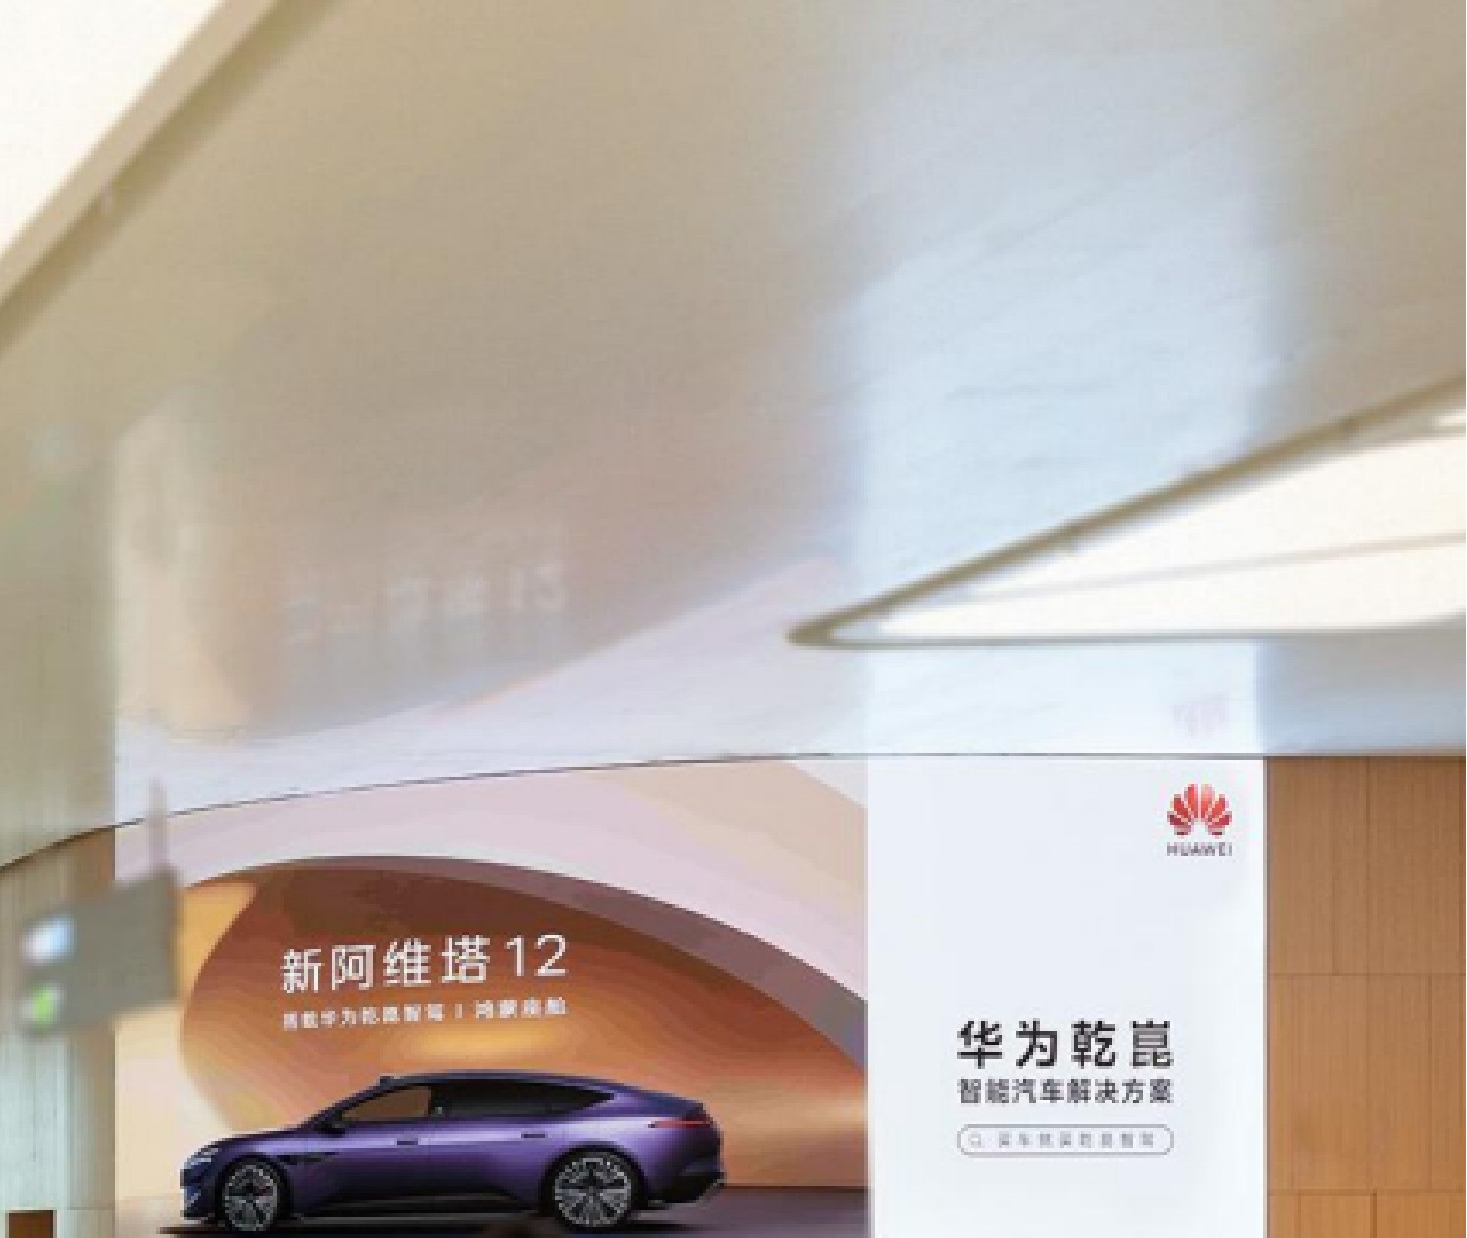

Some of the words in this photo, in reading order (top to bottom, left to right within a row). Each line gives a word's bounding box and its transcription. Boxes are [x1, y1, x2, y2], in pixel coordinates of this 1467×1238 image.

[1166, 842, 1233, 857] HUAWEI
[957, 1019, 1173, 1069] 华为乾崑
[957, 1078, 1174, 1104] 智能汽车解决方案
